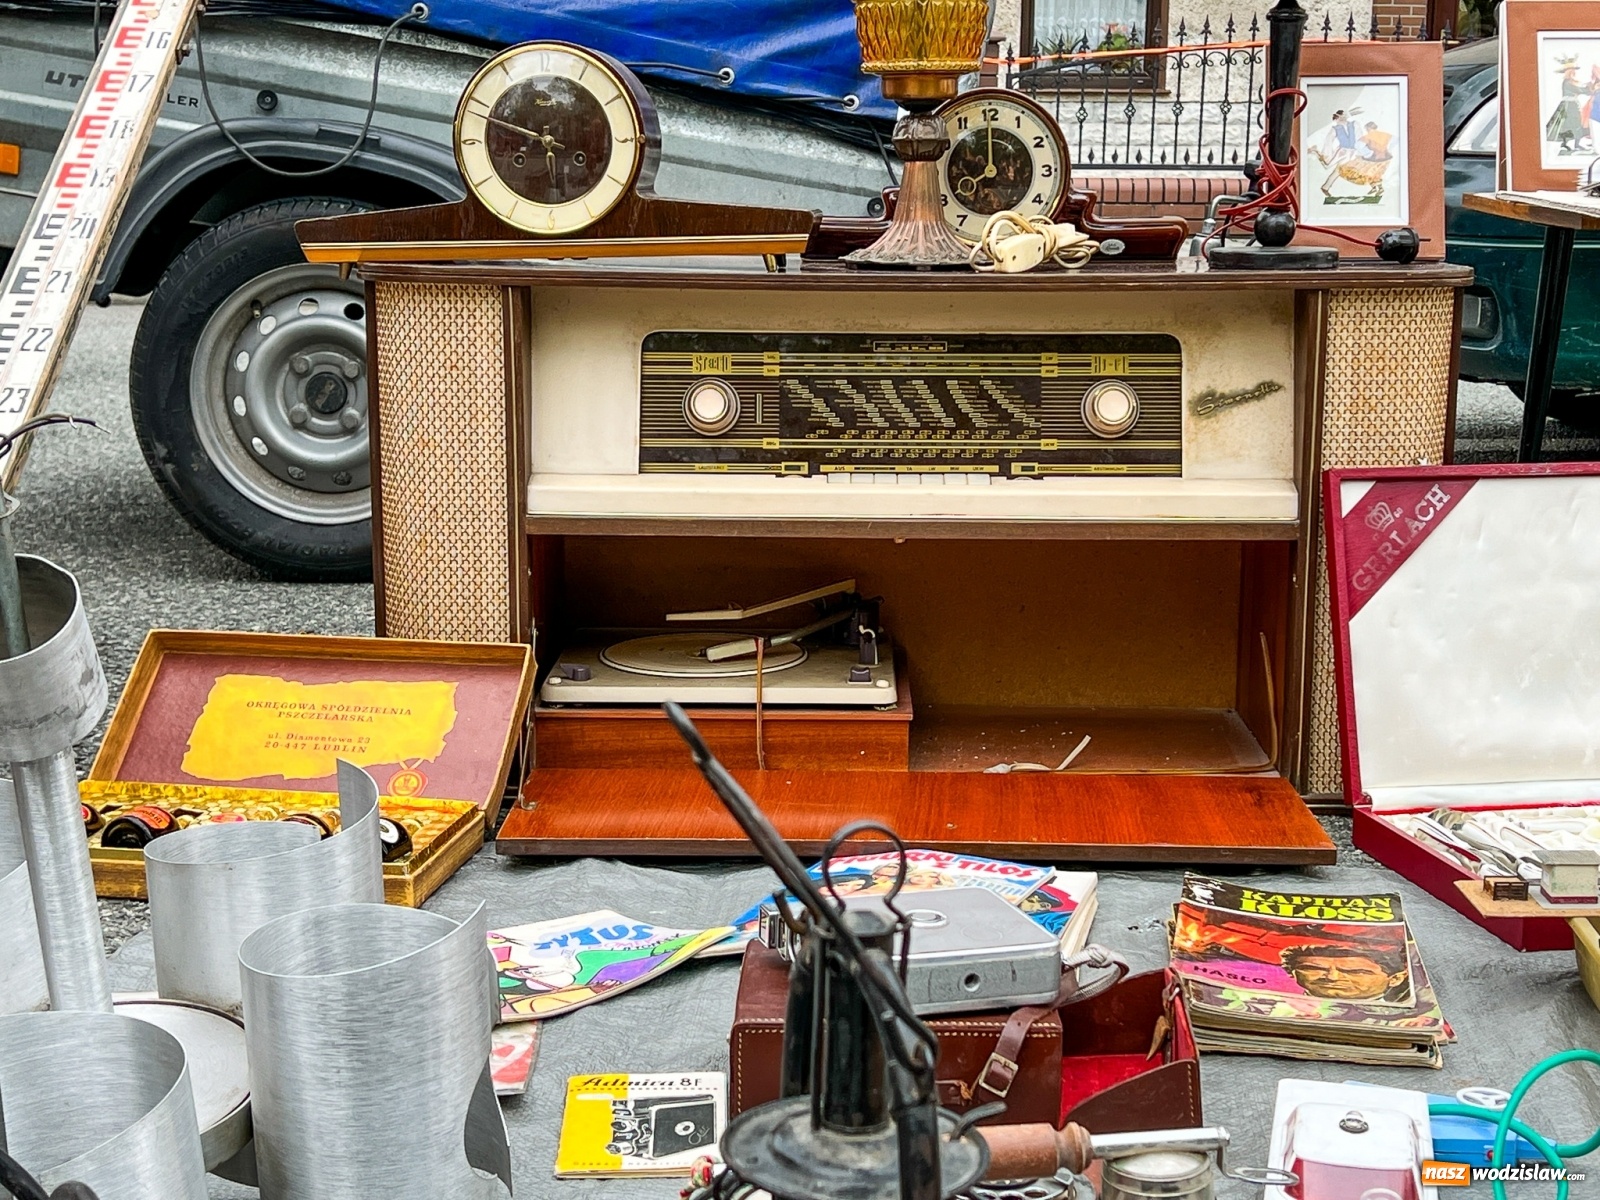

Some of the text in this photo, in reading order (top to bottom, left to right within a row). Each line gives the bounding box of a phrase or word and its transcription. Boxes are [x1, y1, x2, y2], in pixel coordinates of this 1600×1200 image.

[146, 32, 171, 48] 16
[128, 74, 155, 93] 17
[981, 108, 999, 121] 12
[1014, 115, 1021, 129] 1
[957, 116, 968, 130] 11
[1033, 136, 1045, 148] 2
[1041, 164, 1052, 177] 3
[1031, 193, 1044, 205] 4
[956, 214, 968, 226] 7
[44, 270, 72, 293] 21
[20, 327, 53, 352] 22
[0, 386, 31, 414] 23
[1352, 483, 1452, 591] GERLACH
[246, 700, 412, 716] OKRĘGOWA SPÓŁDZIELNIA
[277, 710, 374, 723] PSZCZELARSKA
[267, 732, 371, 744] ul. Diamentowa 23
[264, 741, 368, 754] 20-447 LUBLIN
[957, 860, 1038, 878] TILOS
[1242, 889, 1390, 908] KAPITAN
[1240, 898, 1395, 922] KLOSS
[532, 924, 654, 951] TYTUS
[575, 1077, 675, 1087] Admira
